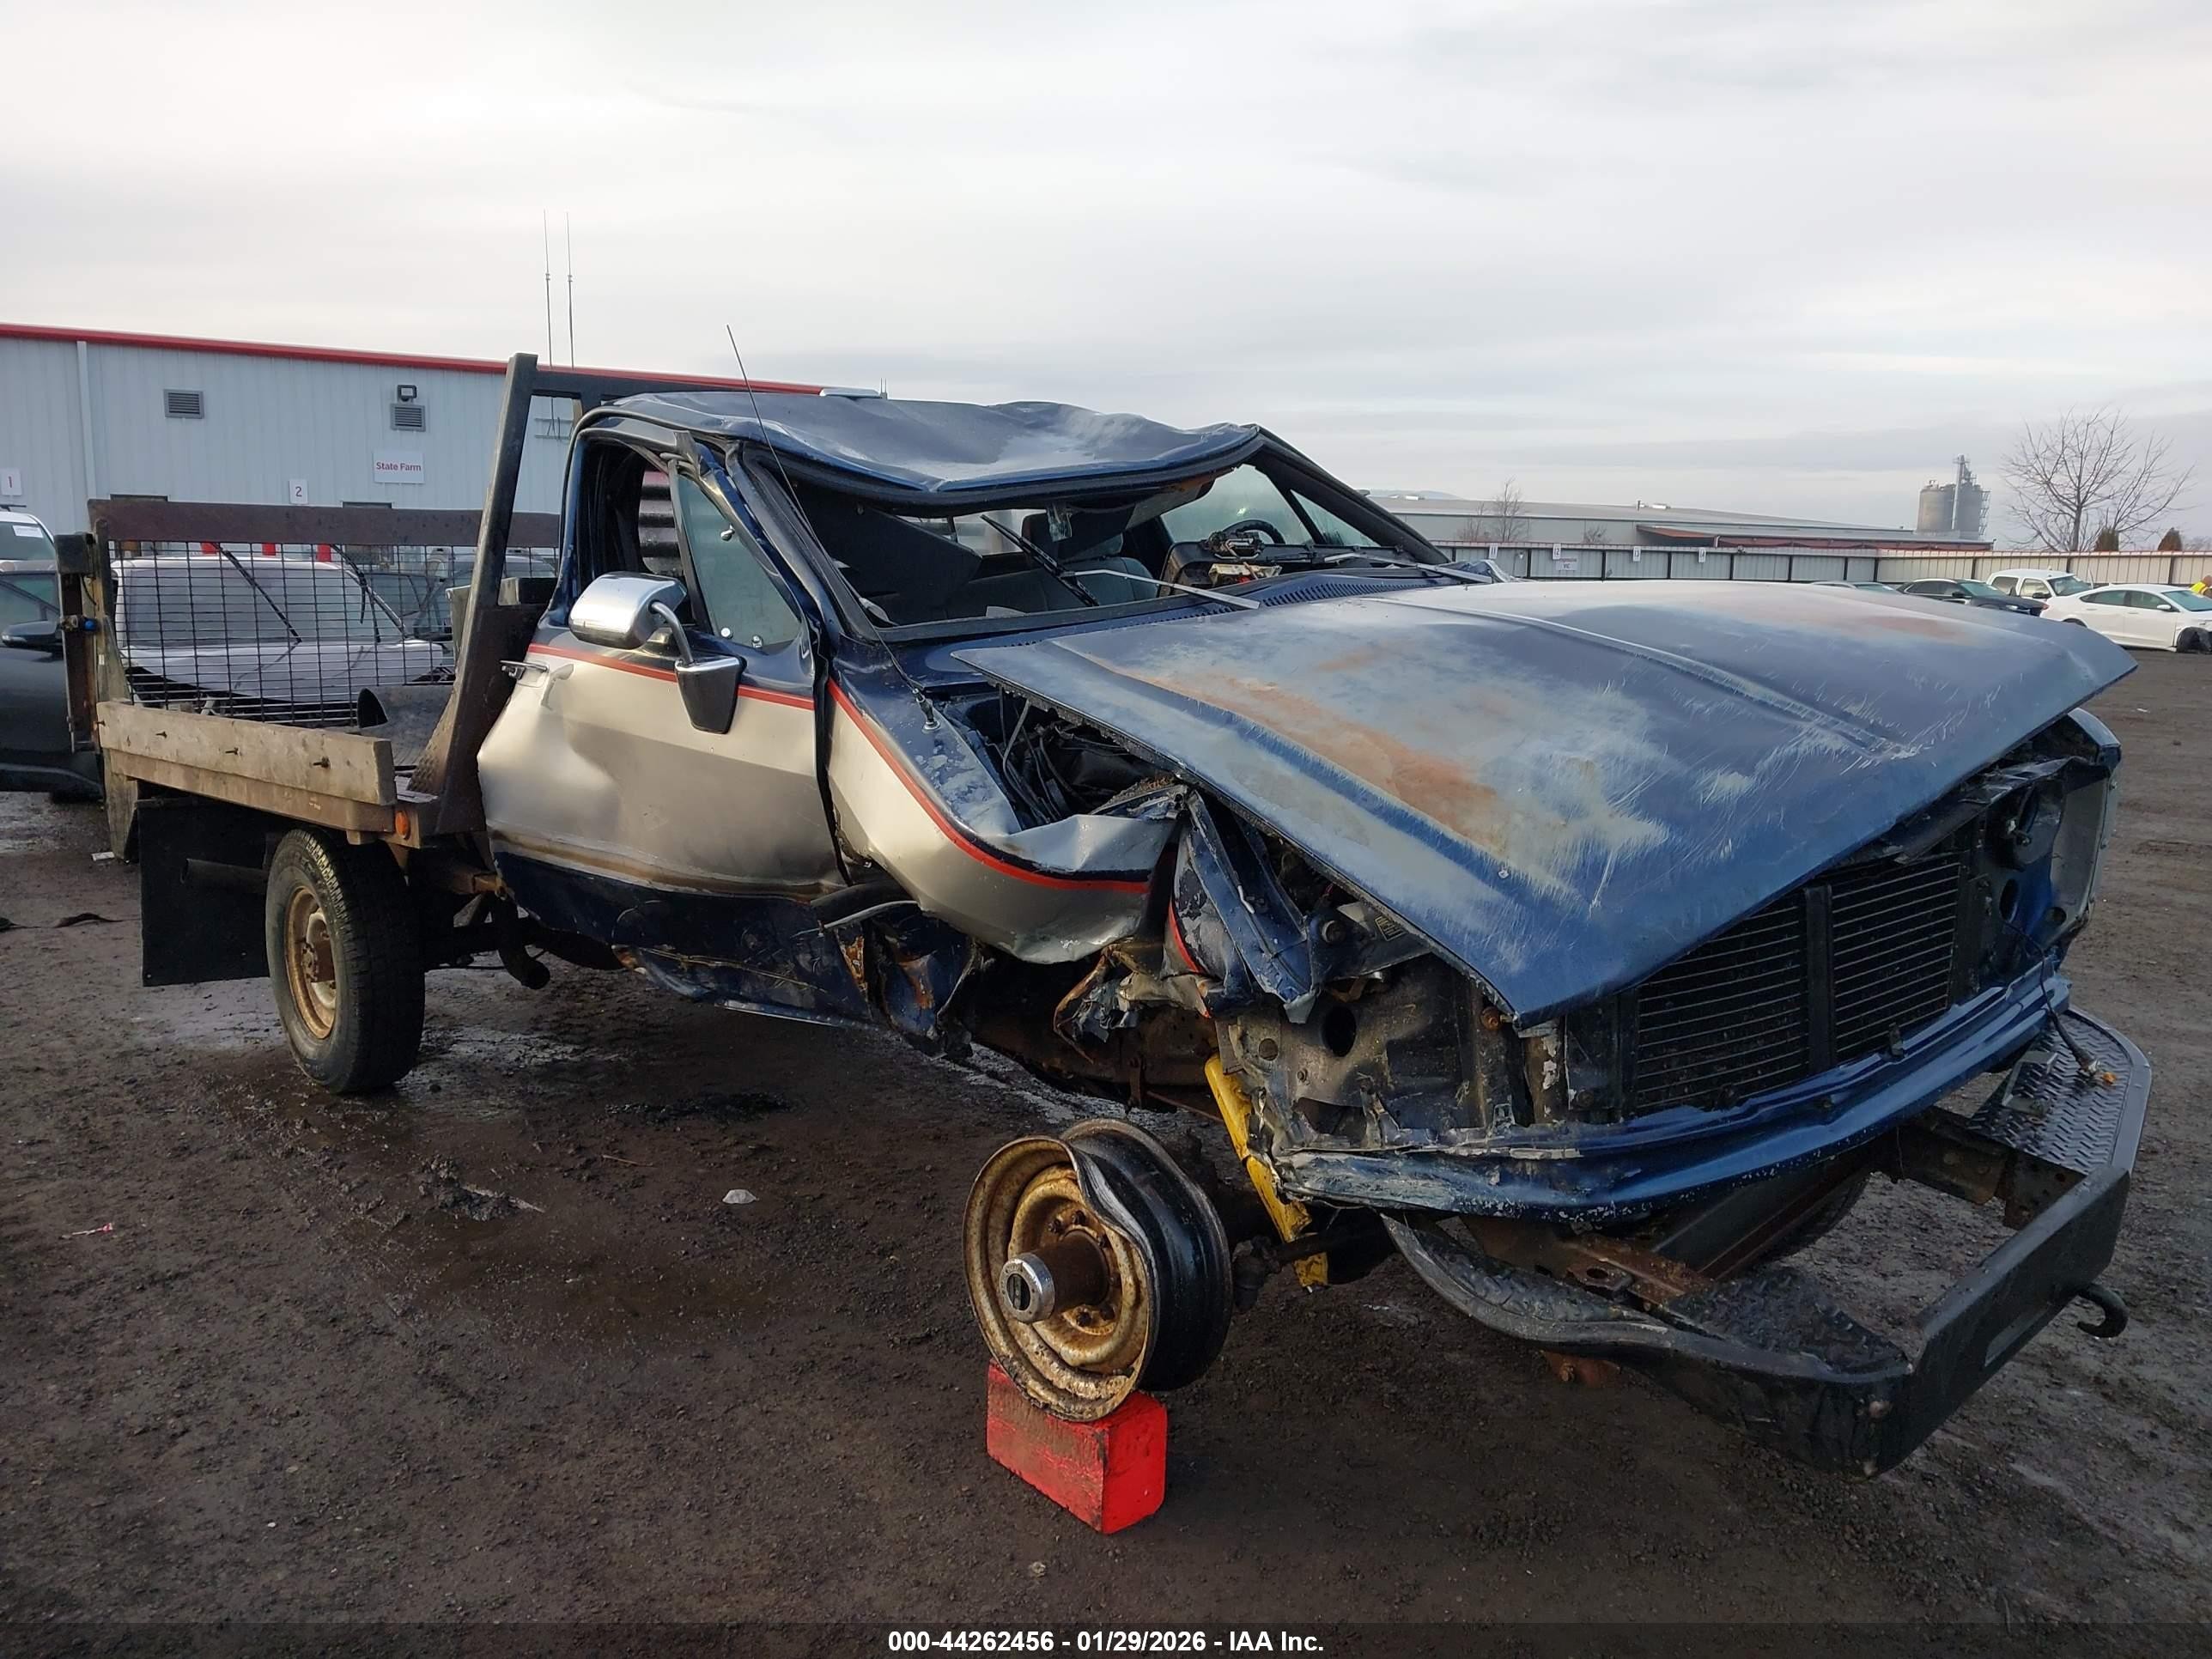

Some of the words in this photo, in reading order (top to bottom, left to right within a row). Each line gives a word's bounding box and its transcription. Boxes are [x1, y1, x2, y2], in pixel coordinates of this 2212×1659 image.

[376, 461, 398, 471] State
[400, 462, 422, 471] Farm
[295, 486, 302, 497] 2
